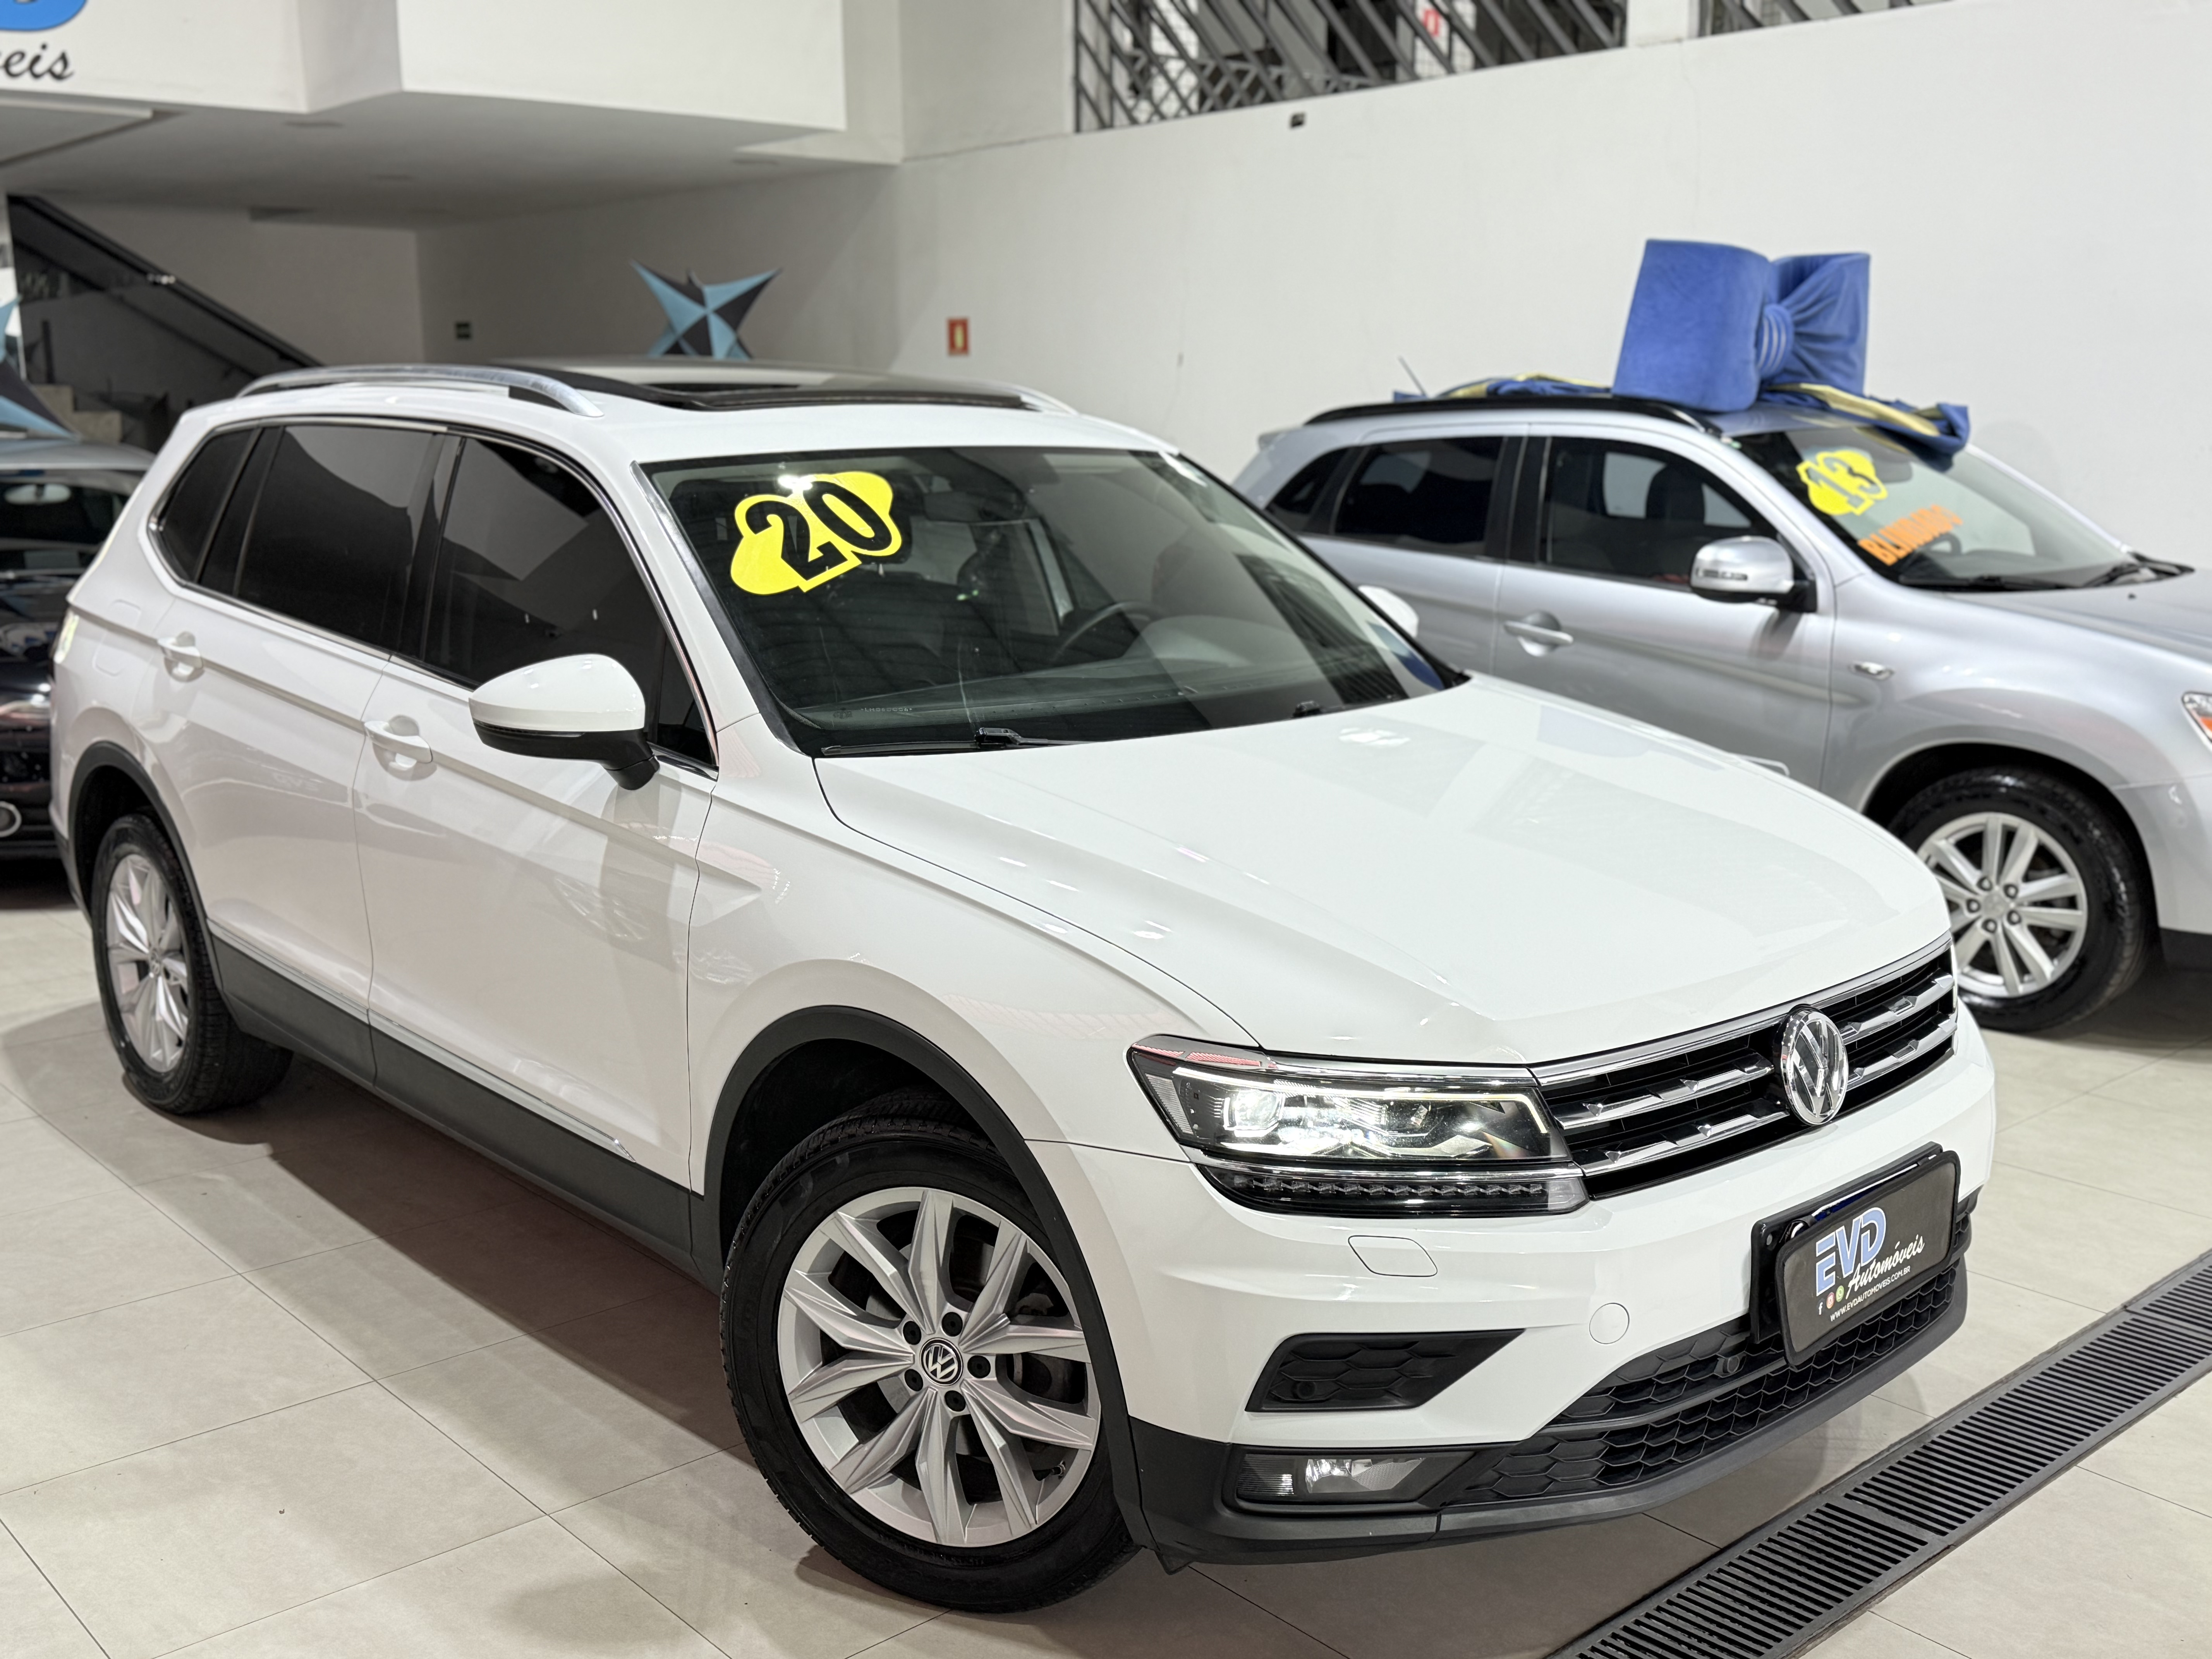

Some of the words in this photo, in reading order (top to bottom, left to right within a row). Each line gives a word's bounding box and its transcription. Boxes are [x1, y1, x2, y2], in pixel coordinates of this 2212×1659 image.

[0, 43, 75, 80] eis
[1805, 455, 1882, 510] 13
[745, 480, 893, 581] 20
[1816, 1206, 1886, 1297] EVD
[1846, 1234, 1925, 1300] Automóveis
[1830, 1265, 1911, 1322] WWW.EVDAUTOMOVEIS.COM.BR
